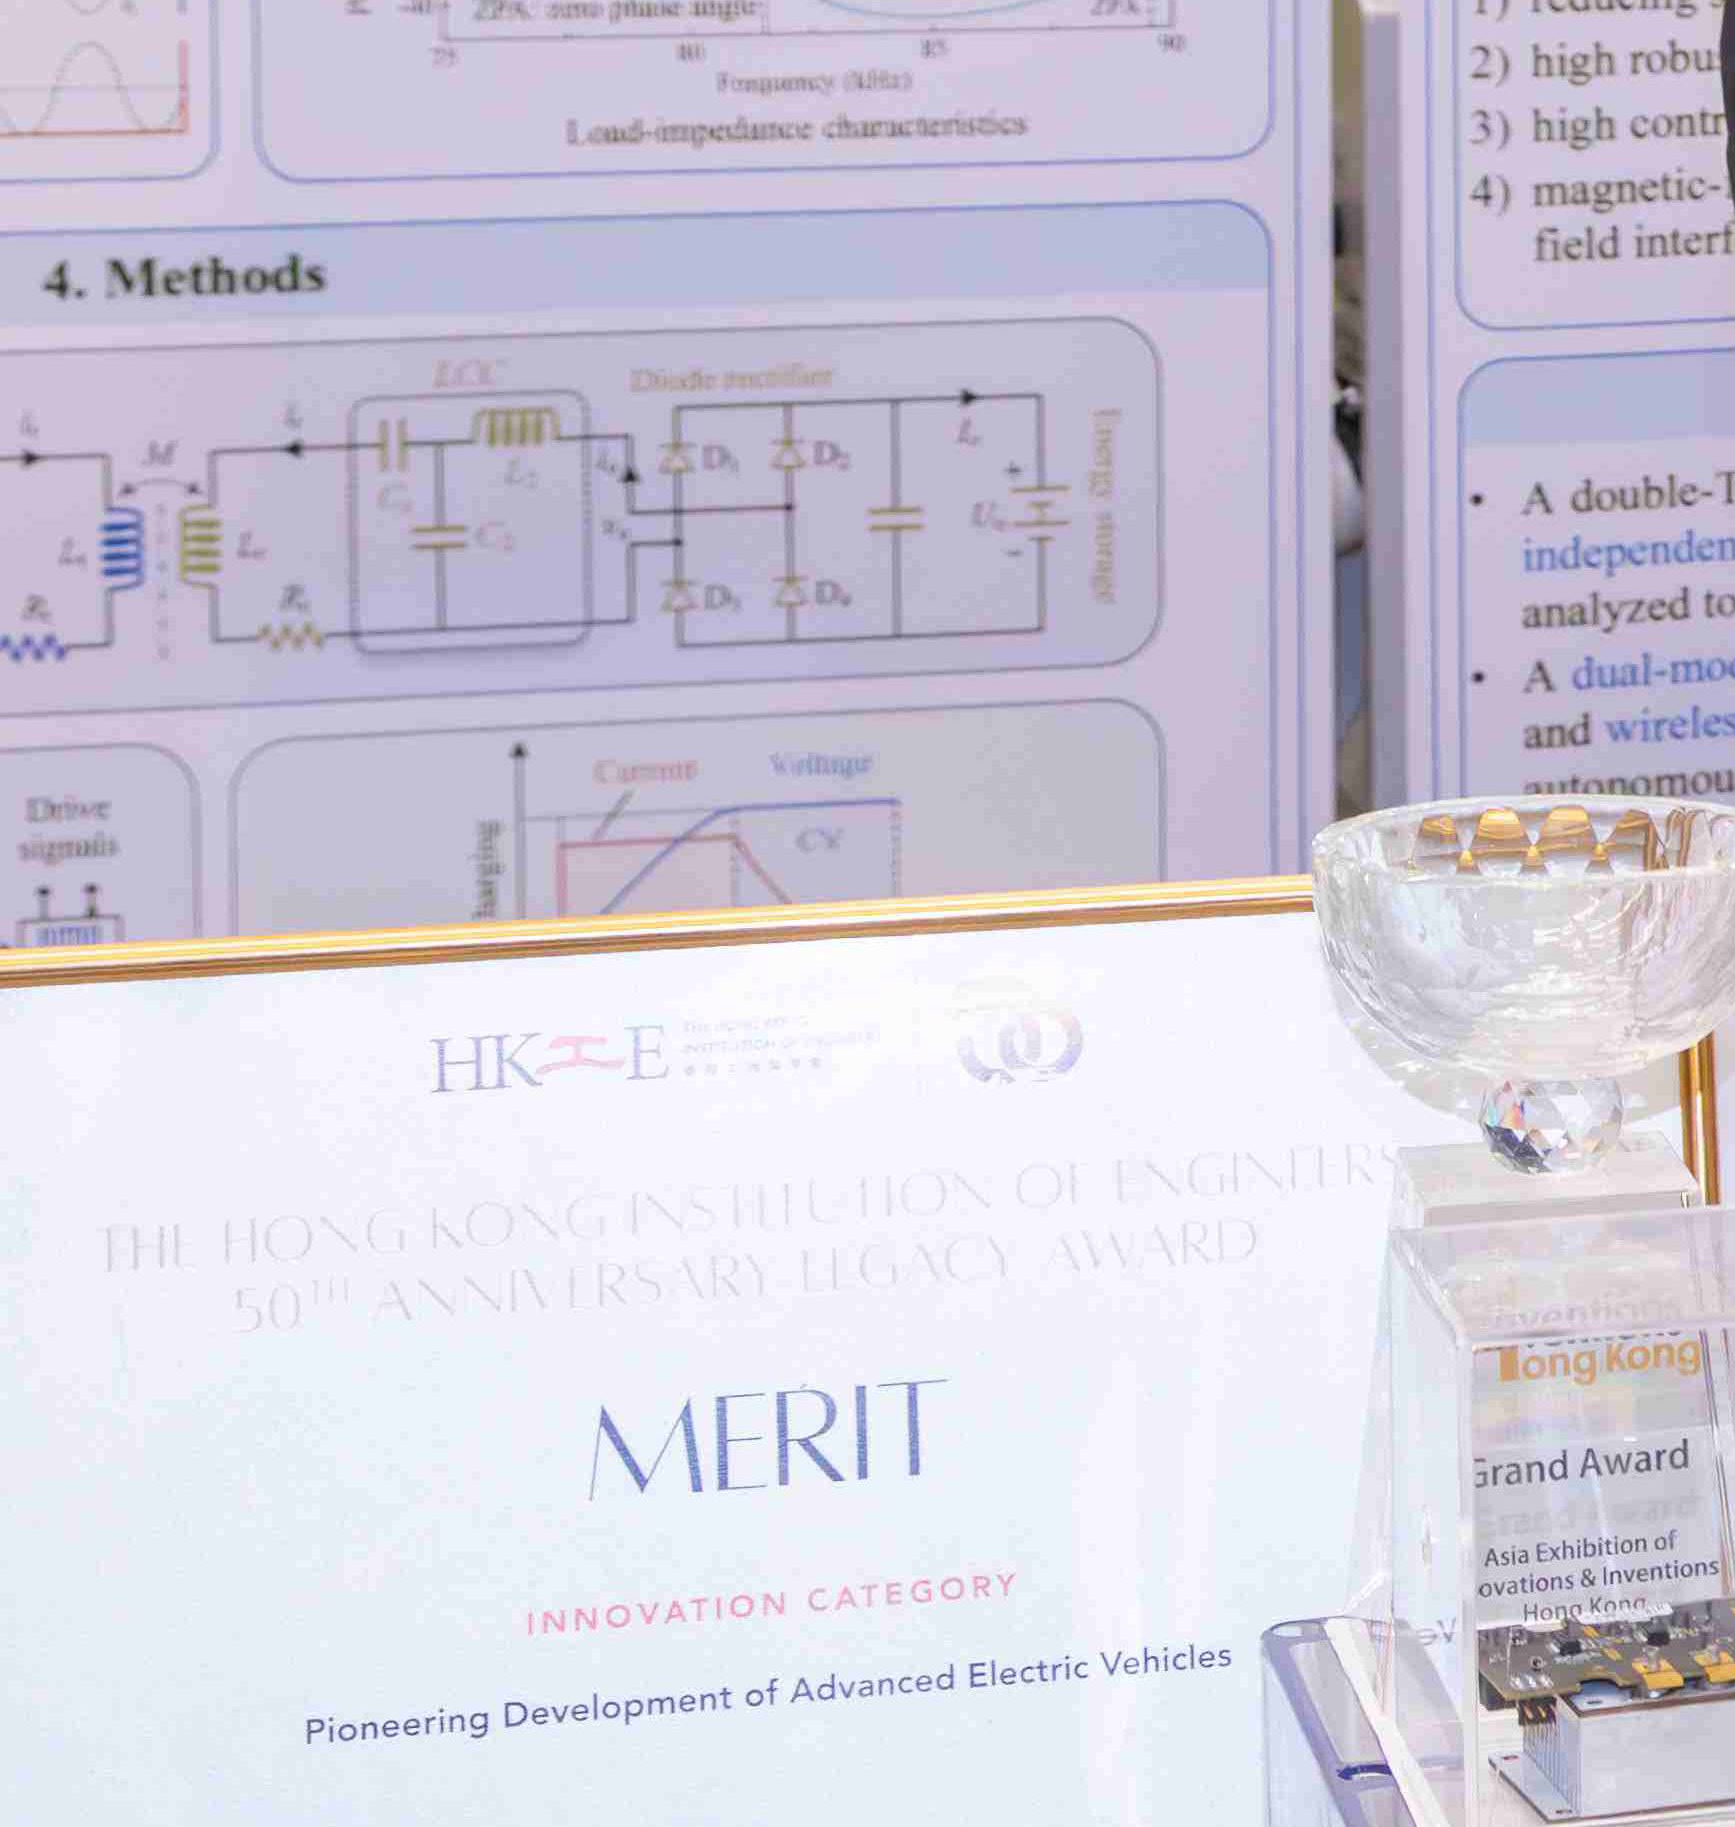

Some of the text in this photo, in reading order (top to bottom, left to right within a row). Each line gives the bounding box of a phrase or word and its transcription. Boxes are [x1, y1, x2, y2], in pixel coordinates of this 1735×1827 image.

[44, 254, 325, 299] 4. Methods
[1524, 660, 1557, 693] A
[590, 1379, 947, 1500] MERIT
[1579, 1438, 1688, 1479] Award
[1484, 1529, 1676, 1568] Asia Exhibition of
[527, 1573, 1016, 1636] INNOVATION CATEGORY
[306, 1644, 1231, 1744] Pioneering Development of Advanced Electric Vehicles
